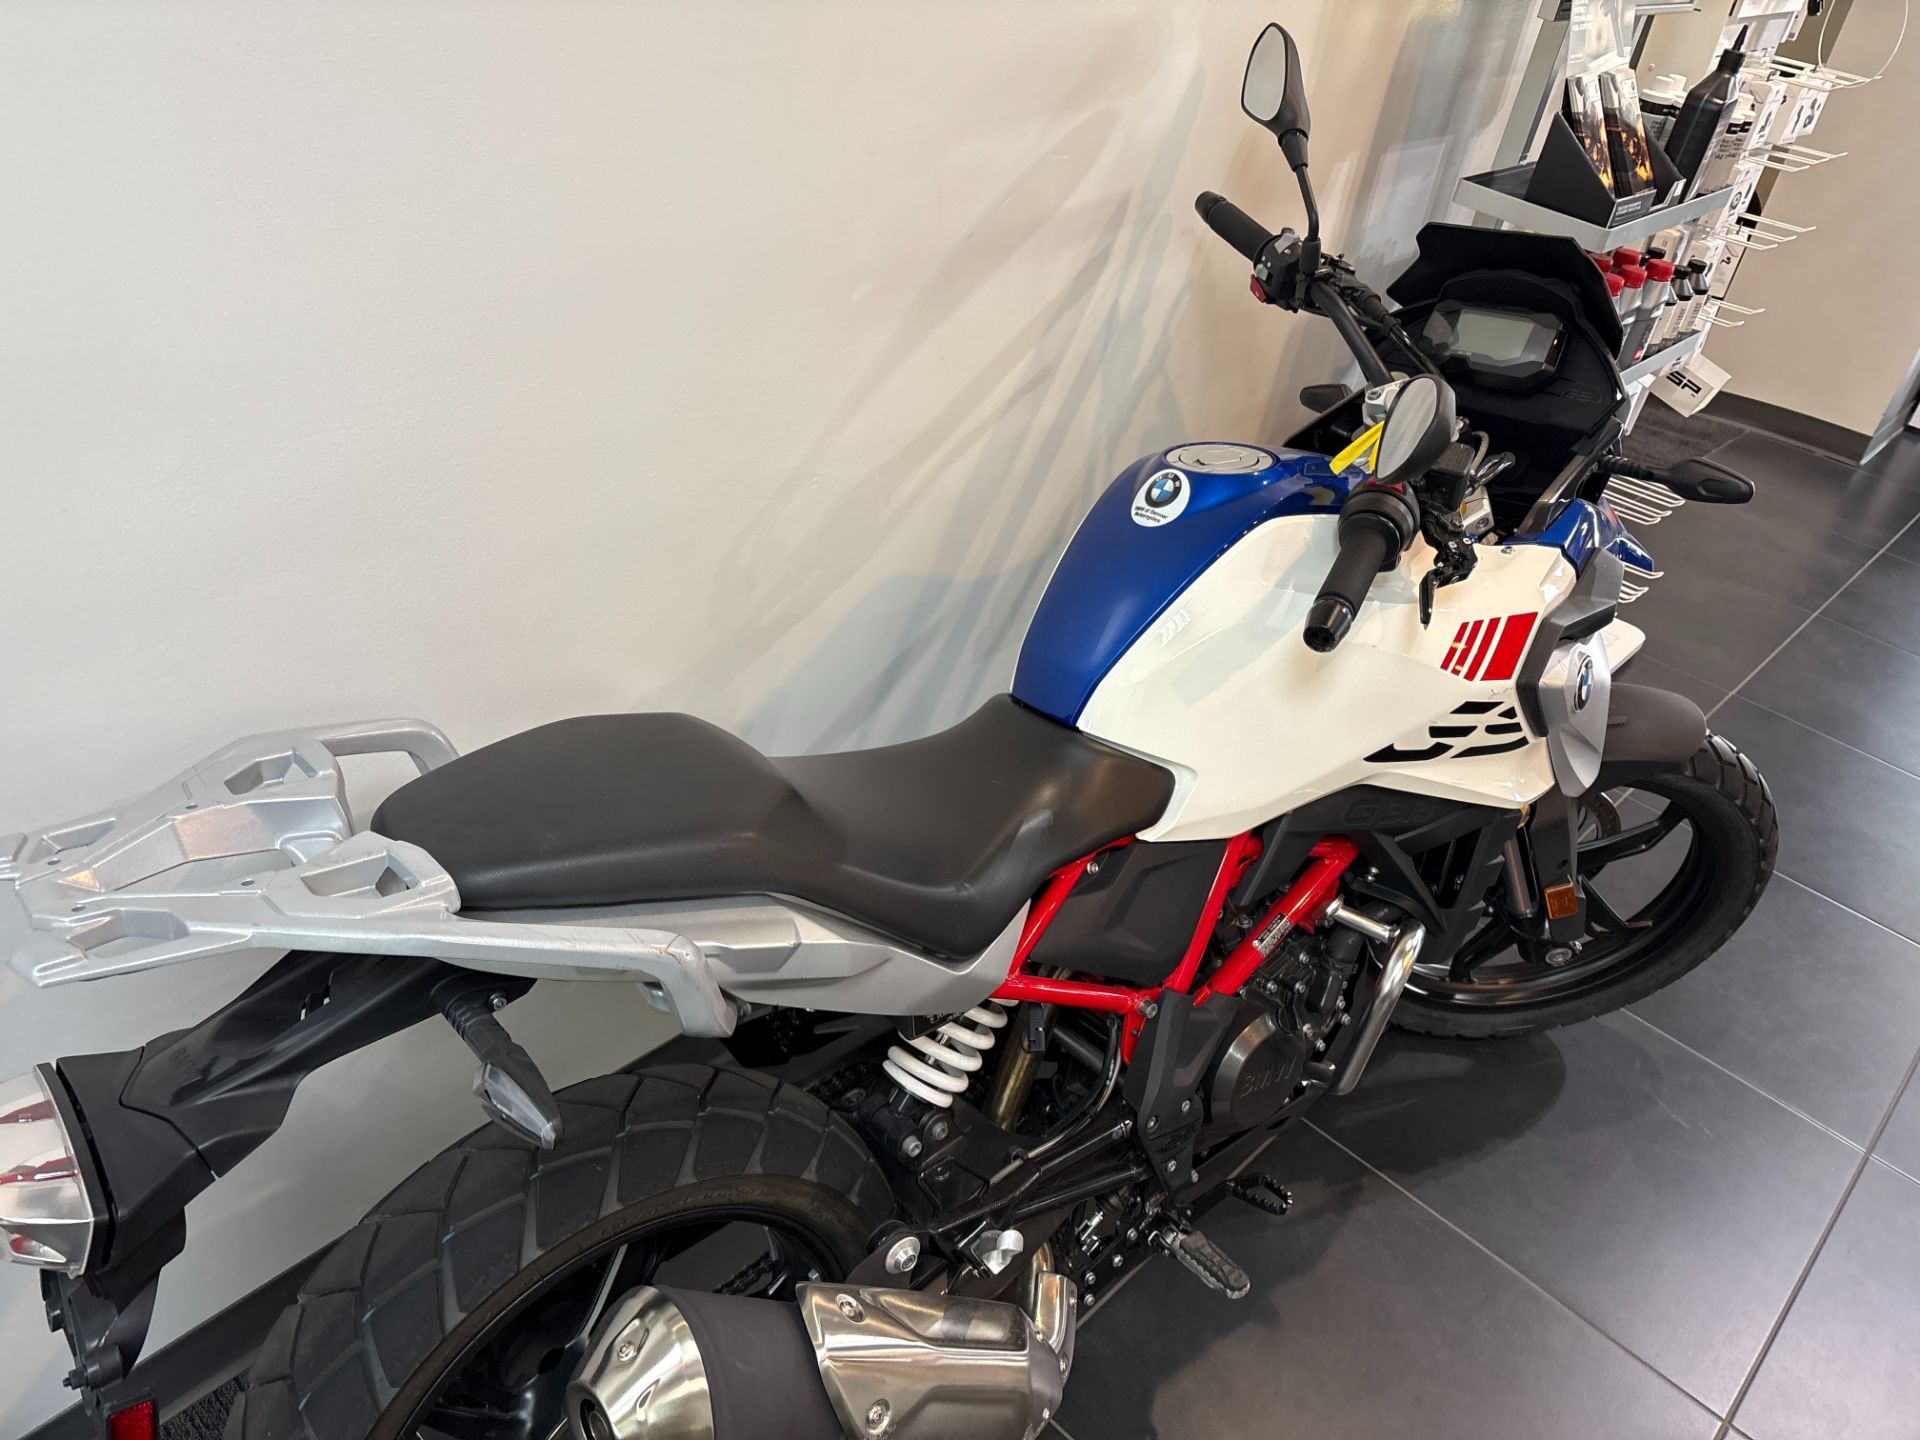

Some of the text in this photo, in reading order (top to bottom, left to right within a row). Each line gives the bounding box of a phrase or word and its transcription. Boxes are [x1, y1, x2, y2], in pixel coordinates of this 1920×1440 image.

[1666, 370, 1702, 394] SP
[1155, 472, 1182, 488] BMW
[1150, 509, 1168, 519] Denver
[1239, 1056, 1298, 1098] BMW
